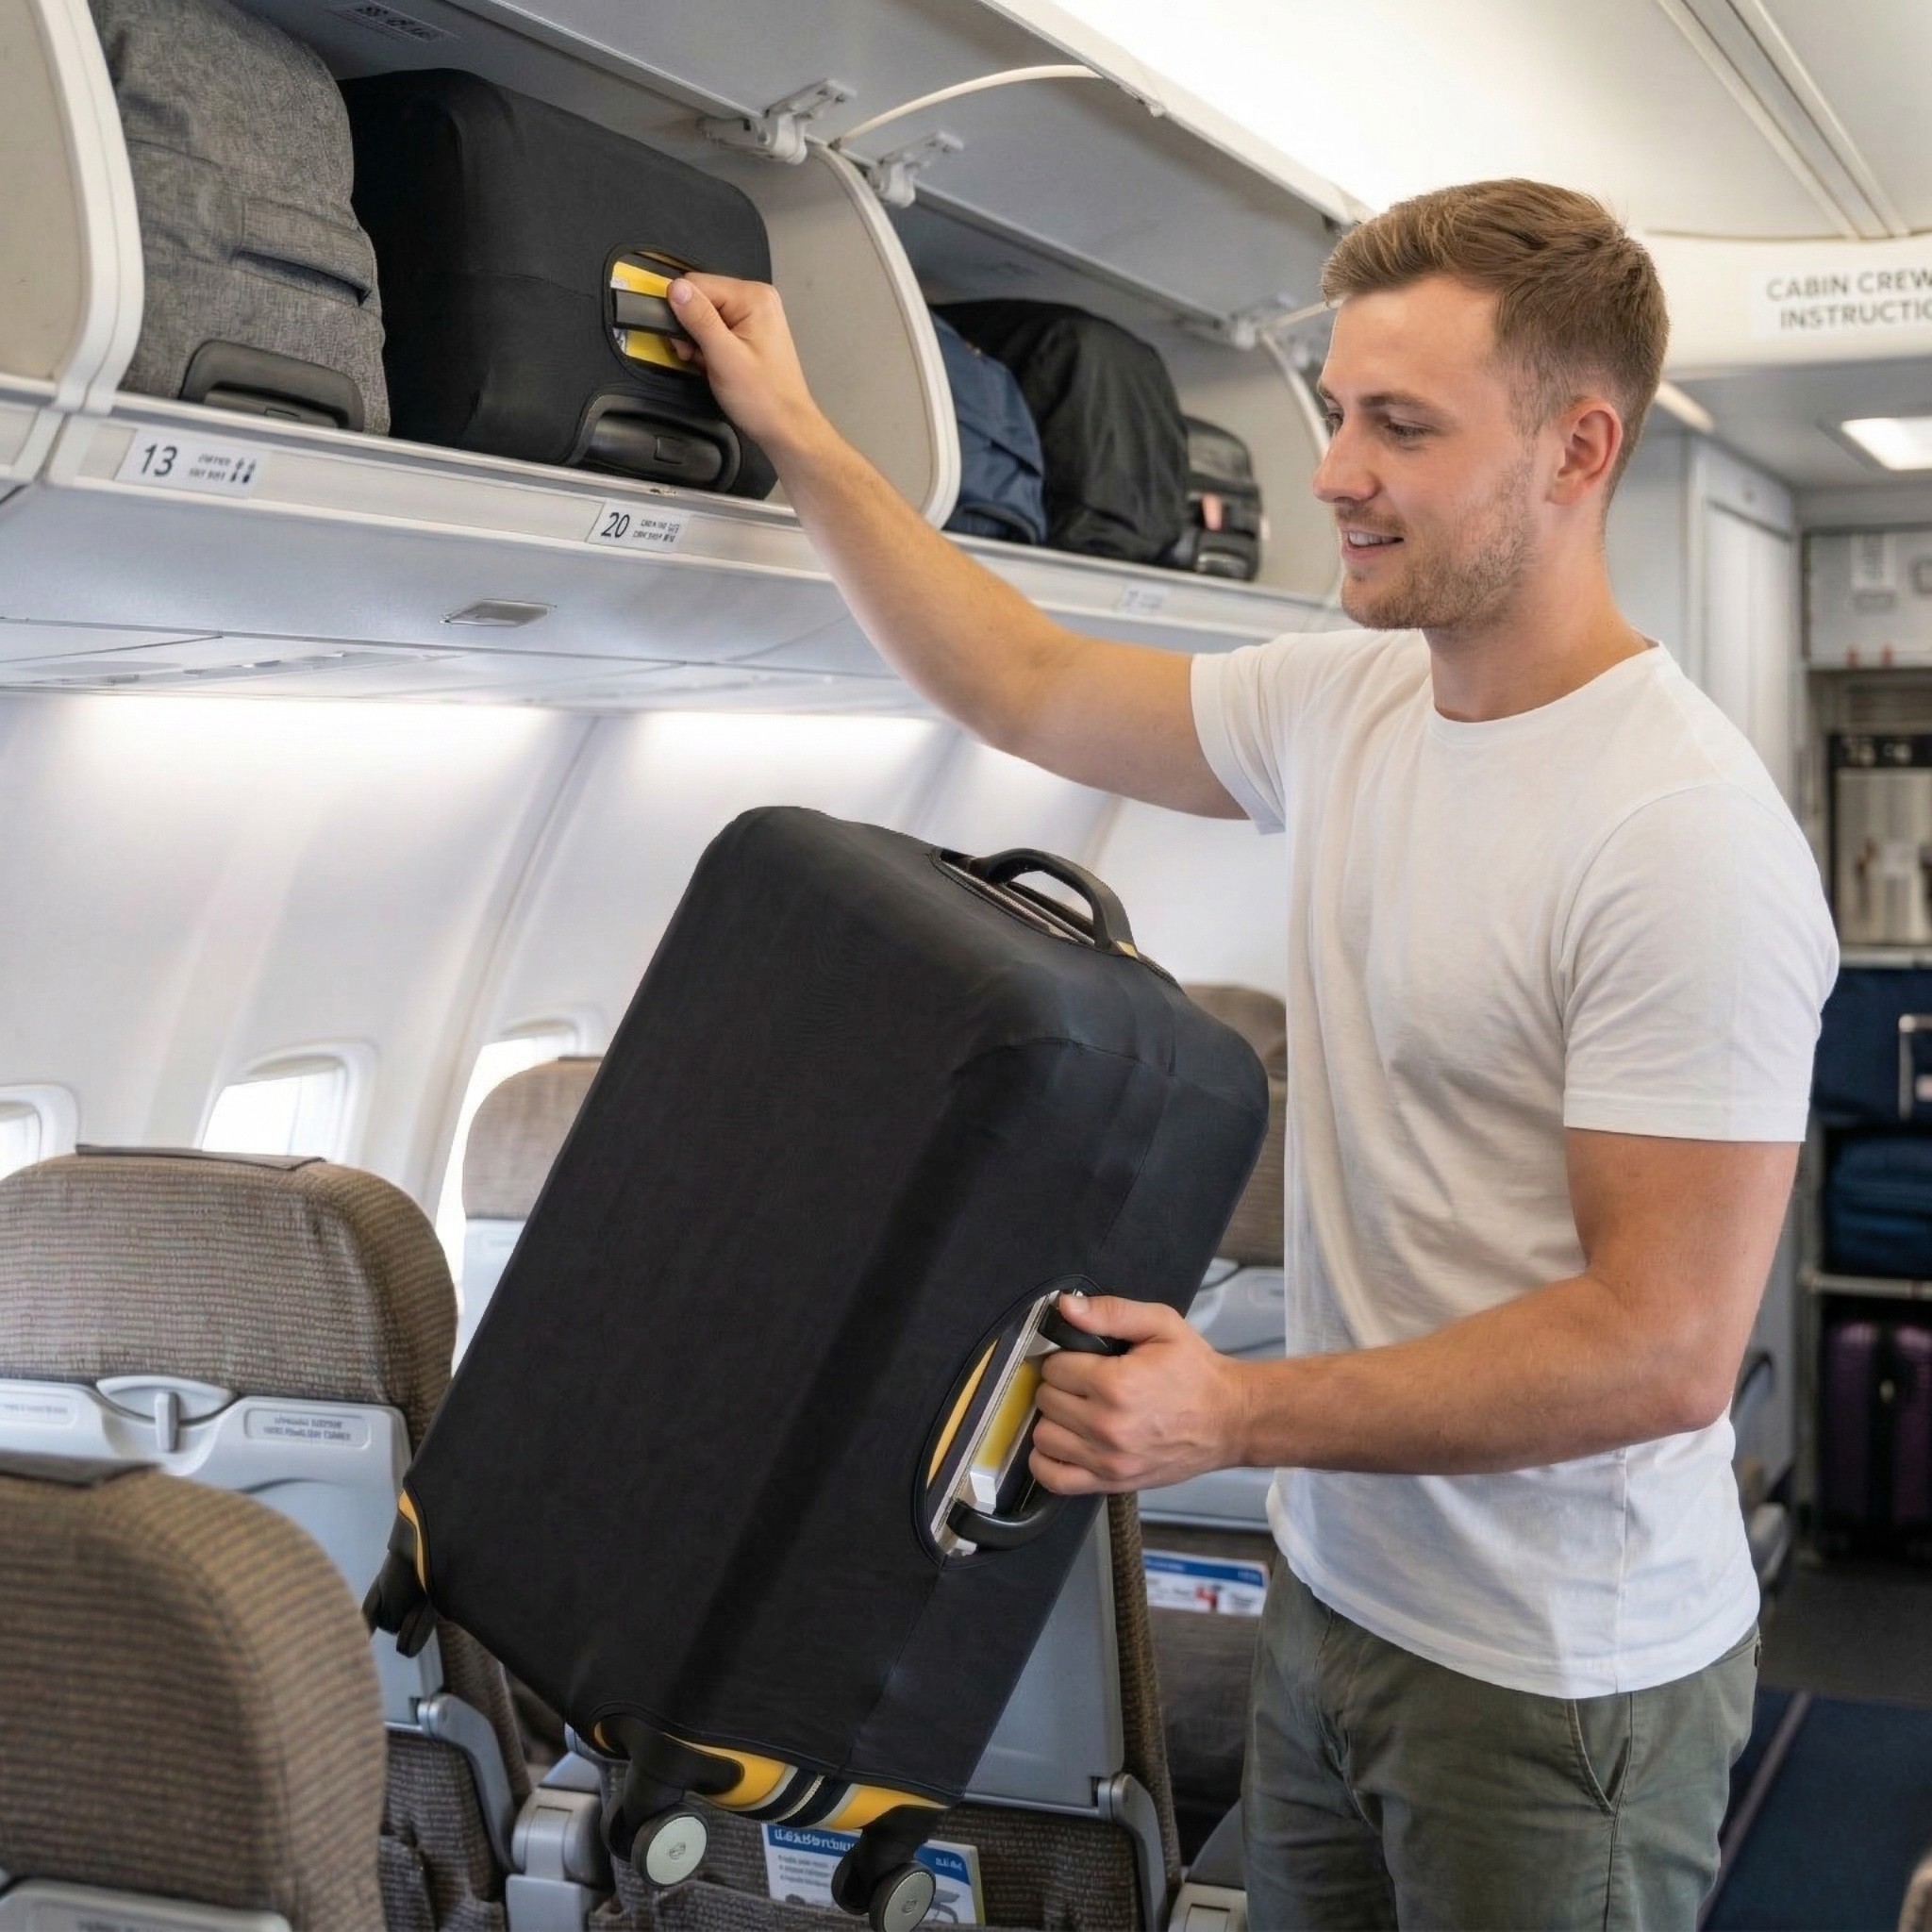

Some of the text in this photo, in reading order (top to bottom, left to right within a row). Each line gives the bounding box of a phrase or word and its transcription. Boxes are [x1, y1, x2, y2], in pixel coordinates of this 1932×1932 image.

[1766, 268, 1932, 301] CABIN CREW
[142, 443, 178, 476] 13
[601, 511, 630, 538] 20
